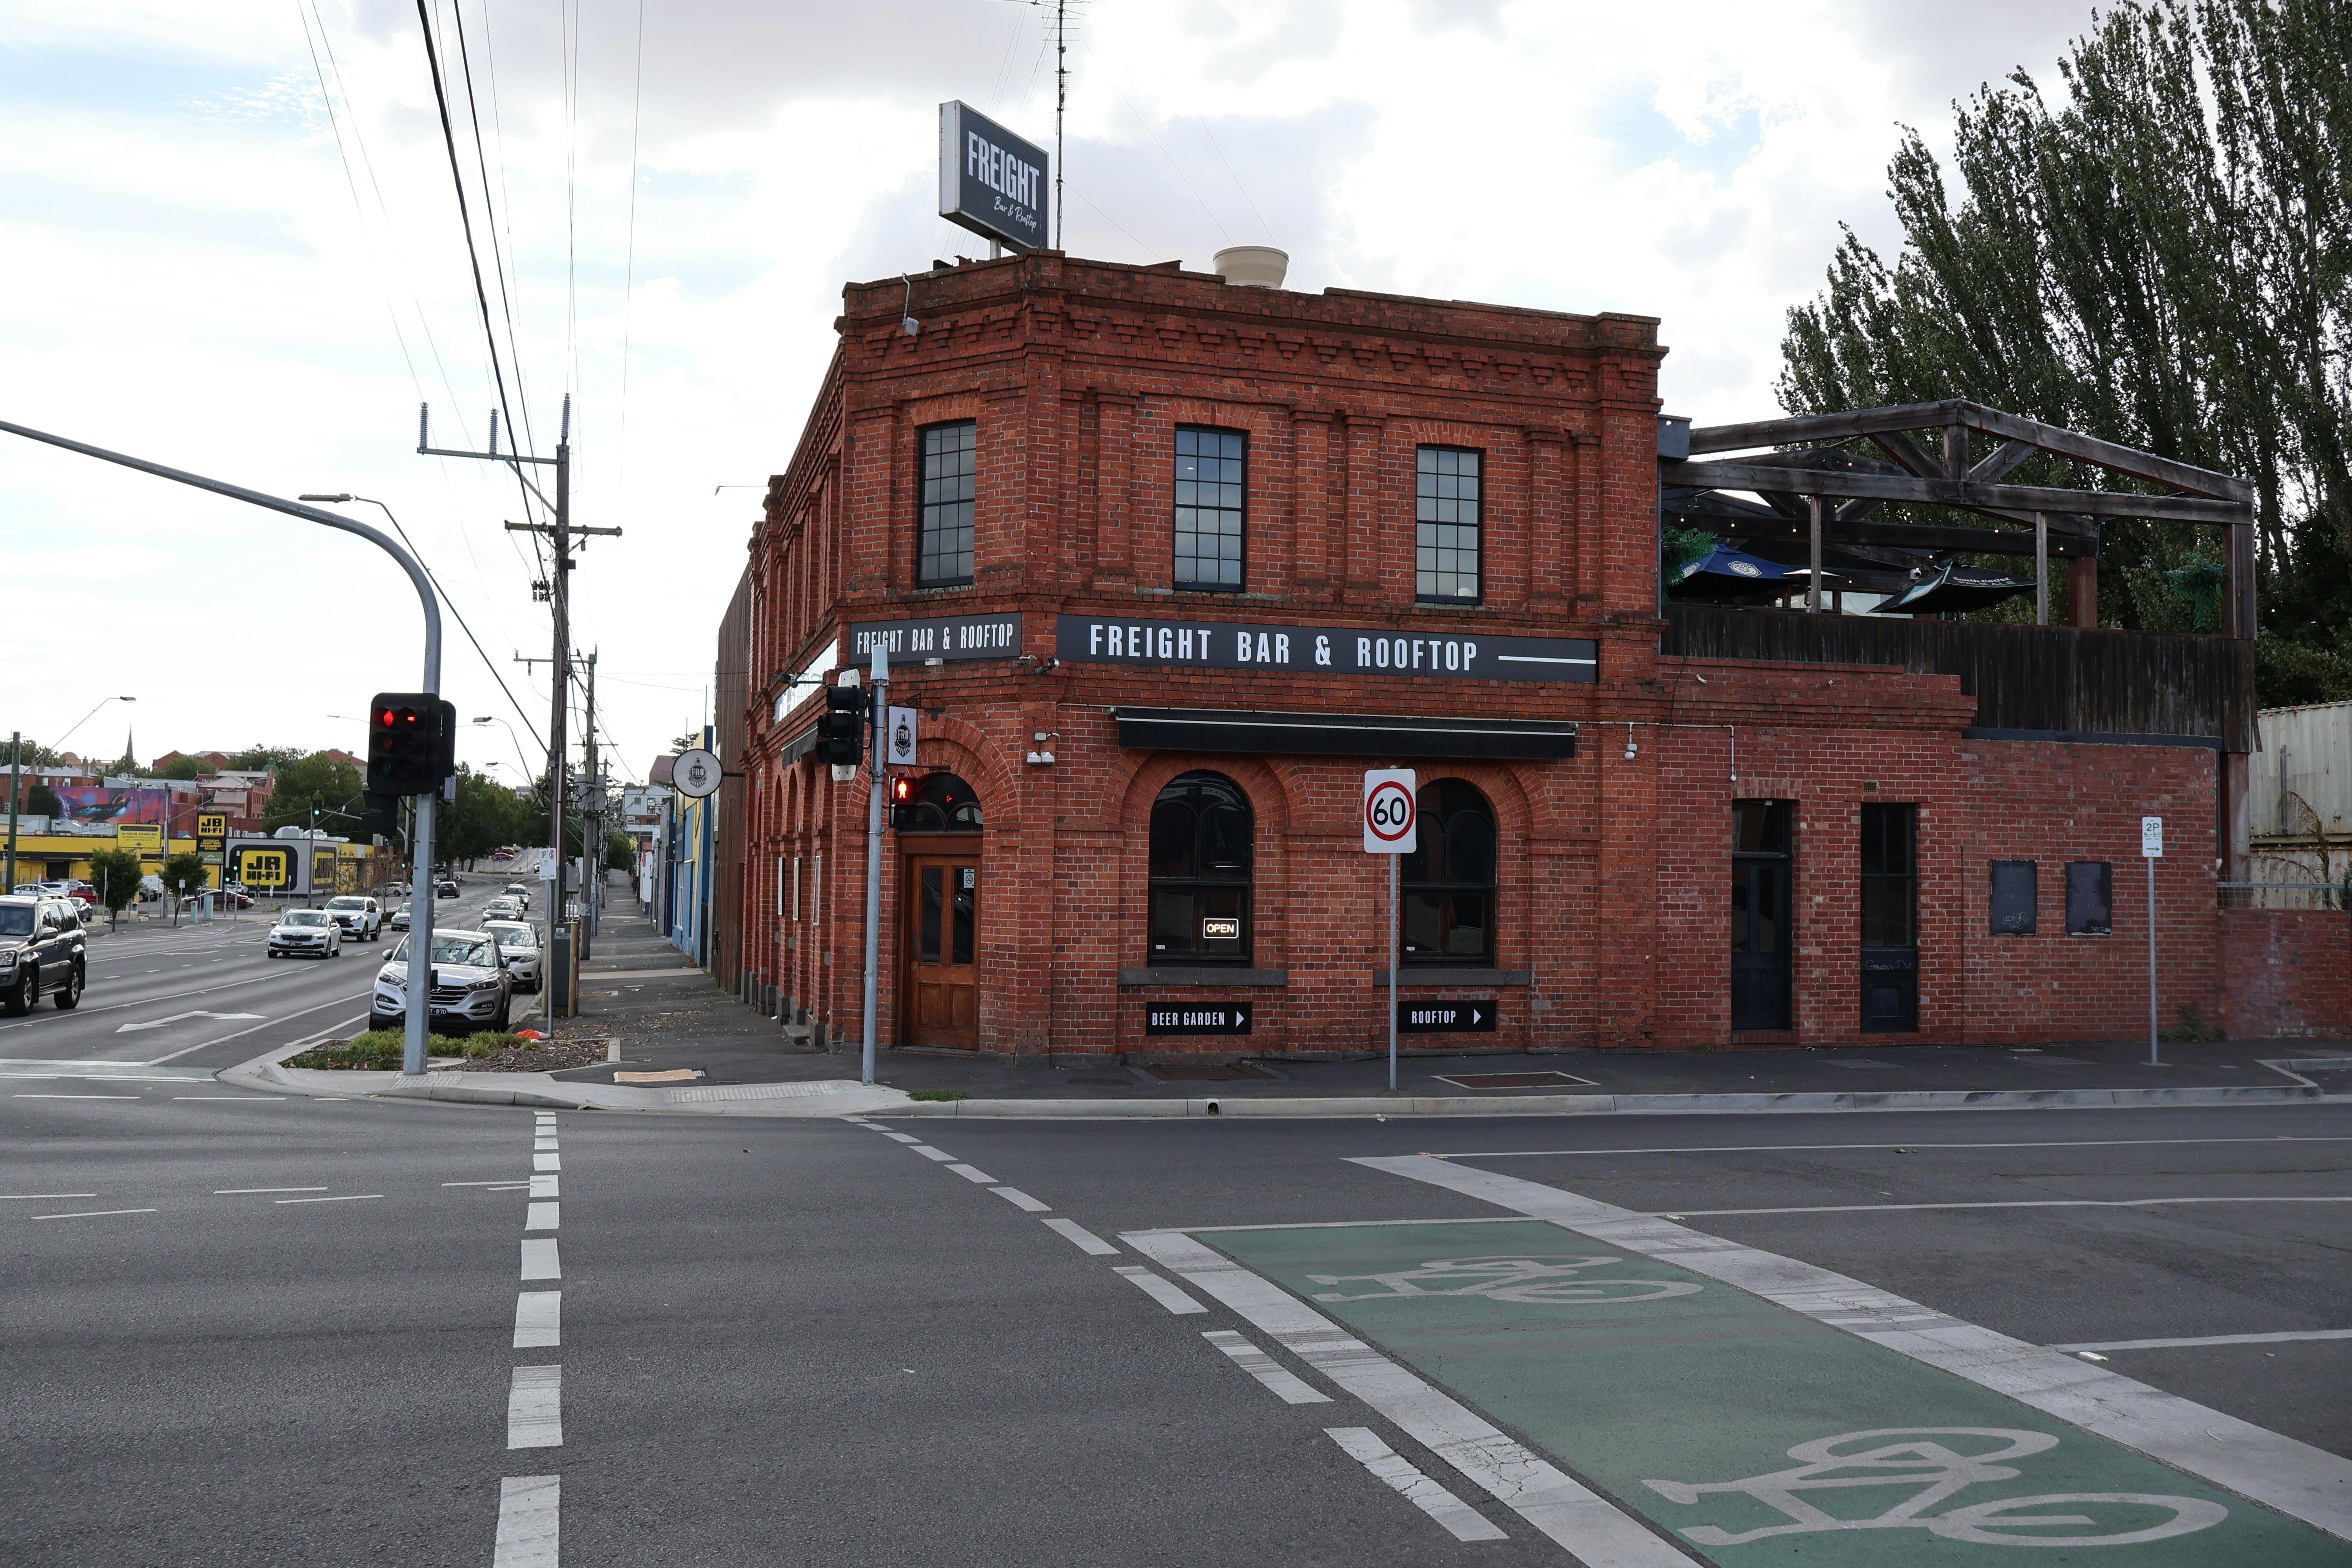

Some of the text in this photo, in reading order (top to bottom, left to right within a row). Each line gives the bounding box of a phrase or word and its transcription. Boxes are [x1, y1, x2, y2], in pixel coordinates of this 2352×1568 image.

[968, 130, 1039, 211] FREIGHT
[994, 196, 1036, 234] Bar & Rooftop
[857, 623, 1013, 654] FREIGHT BAR & ROOFTOP
[1090, 624, 1477, 671] FREIGHT BAR & ROOFTOP
[898, 729, 909, 740] FR8
[691, 768, 704, 776] FR8
[1373, 797, 1406, 826] 60
[201, 818, 222, 827] JB
[2146, 823, 2160, 831] 2P
[247, 856, 280, 870] JB
[1207, 924, 1234, 933] OPEN
[1152, 1012, 1225, 1026] BEER GARDEN
[1412, 1010, 1456, 1024] ROOFTOP
